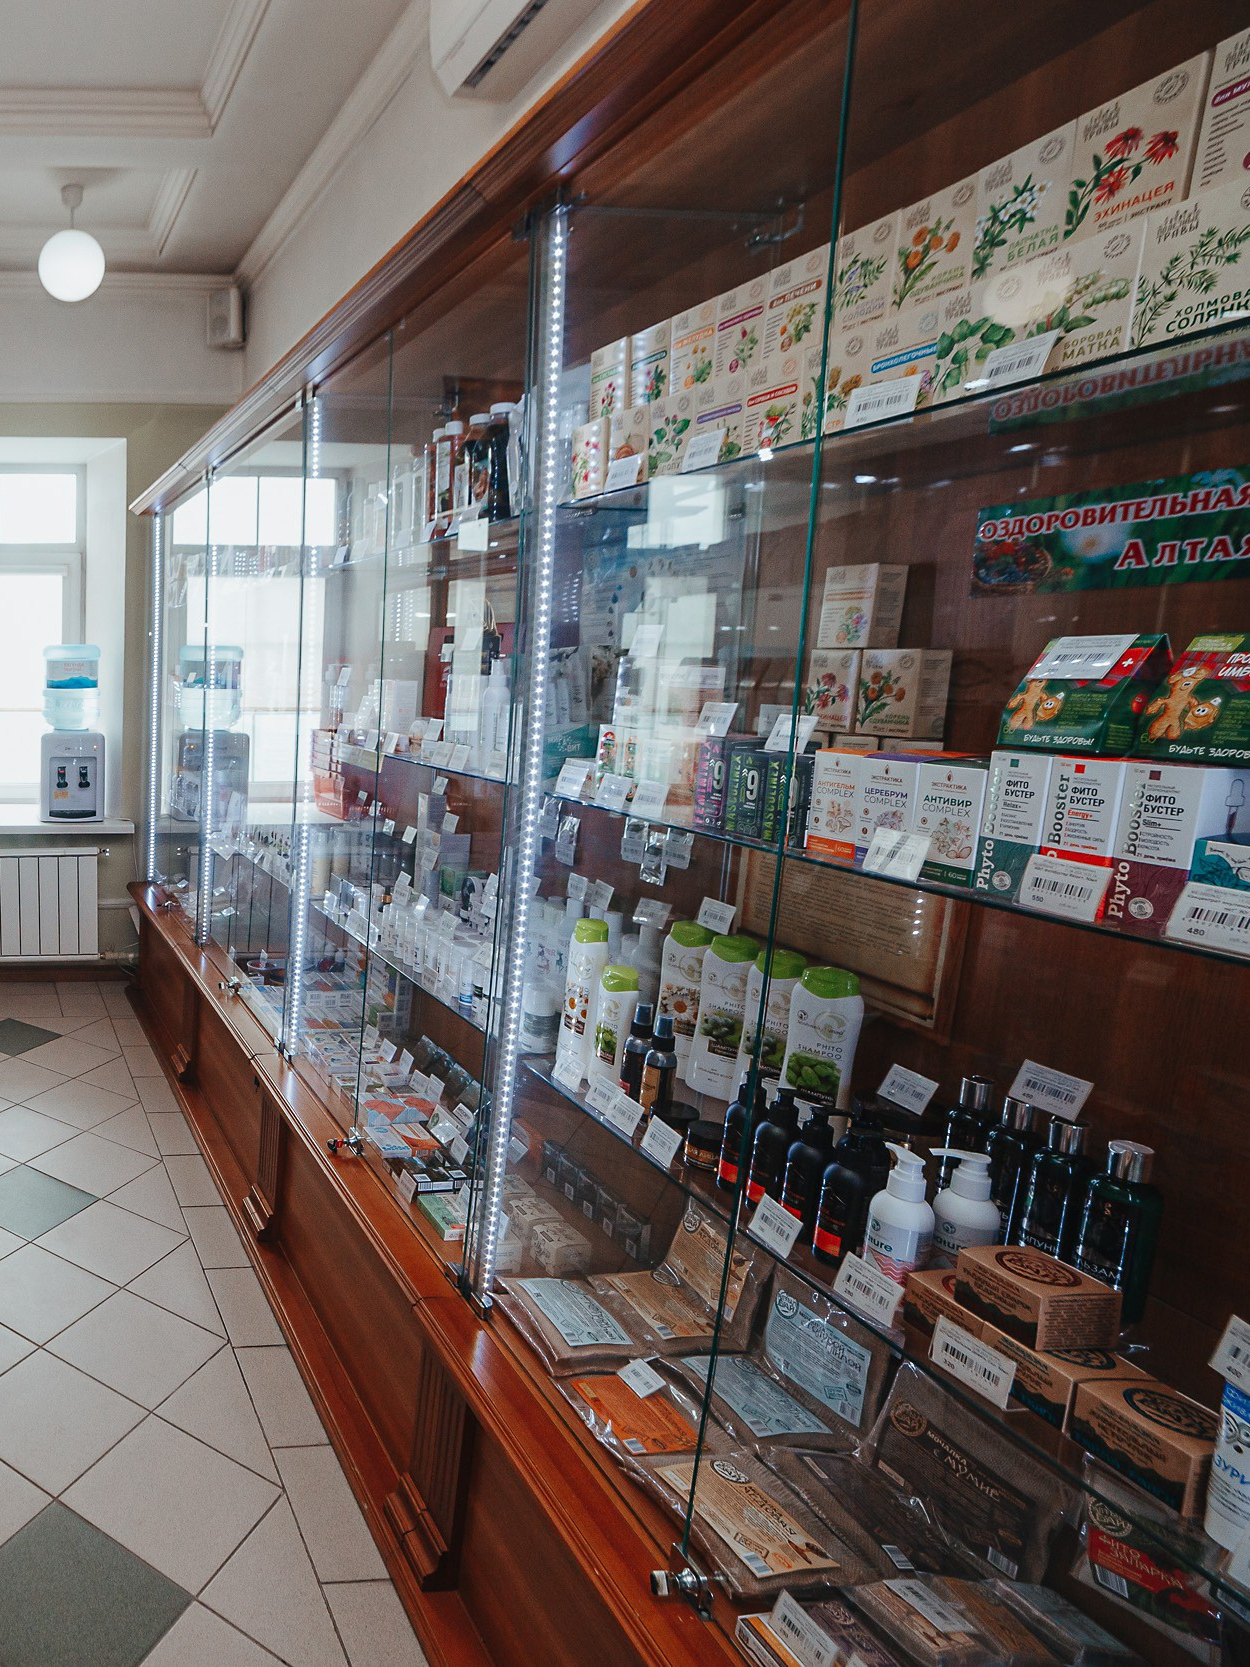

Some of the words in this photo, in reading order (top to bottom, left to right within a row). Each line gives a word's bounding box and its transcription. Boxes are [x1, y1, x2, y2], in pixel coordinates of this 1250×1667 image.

[1093, 180, 1176, 223] ЭХИНАЦЕЯ
[1130, 198, 1173, 220] ЭКСТРАКТ
[1157, 220, 1199, 244] ТРАВЫ
[1007, 233, 1059, 262] БЕЛАЯ
[1063, 325, 1122, 350] БОРОВАЯ
[1061, 336, 1121, 362] МАТКА
[980, 484, 1250, 540] ОЗДОРОВИТЕЛЬНАЯ
[819, 713, 847, 722] ХИНАЦЕЯ
[1024, 734, 1051, 744] БУДЬТЕ
[1053, 736, 1095, 746] ЗДОРОВЫ!
[1169, 744, 1206, 756] БУДЬТЕ
[1208, 747, 1250, 760] ЗДОРОВ
[712, 760, 726, 790] 9
[823, 767, 852, 775] ЭКСТРАКТИКА
[746, 769, 758, 800] 9
[871, 774, 904, 783] ЭКСТРАКТИКА
[1006, 779, 1030, 789] ФИТО
[816, 786, 855, 798] COMPLEX
[817, 780, 855, 791] АНТИГЕЛЬМ
[931, 781, 967, 791] ЭКСТРАКТИКА
[1071, 786, 1098, 797] ФИТО
[864, 786, 908, 800] ЦЕРЕБРУМ
[1004, 788, 1035, 799] БУСТЕР
[1145, 793, 1176, 806] ФИТО
[863, 795, 907, 808] COMPLEX
[923, 793, 972, 808] АНТИВИР
[1002, 801, 1022, 810] Relax+
[1069, 796, 1105, 807] БУСТЕР
[922, 803, 971, 817] COMPLEX
[1047, 774, 1070, 846] Booster
[1067, 809, 1093, 819] Energy+
[1143, 804, 1185, 817] БУСТЕР
[1142, 818, 1162, 828] Slim+
[976, 838, 995, 890] Phyto
[948, 870, 958, 878] 60
[1107, 861, 1130, 919] Phyto
[1187, 927, 1205, 936] 480
[750, 1020, 788, 1036] SHMPOO
[766, 1019, 789, 1029] PHITO
[798, 1044, 842, 1060] SHAMPOO
[816, 1042, 843, 1053] PHITO
[926, 1430, 967, 1465] МОЧАЛКА
[1098, 1534, 1141, 1559] ФИТО
[1110, 1549, 1184, 1591] ЗАПАРКА
